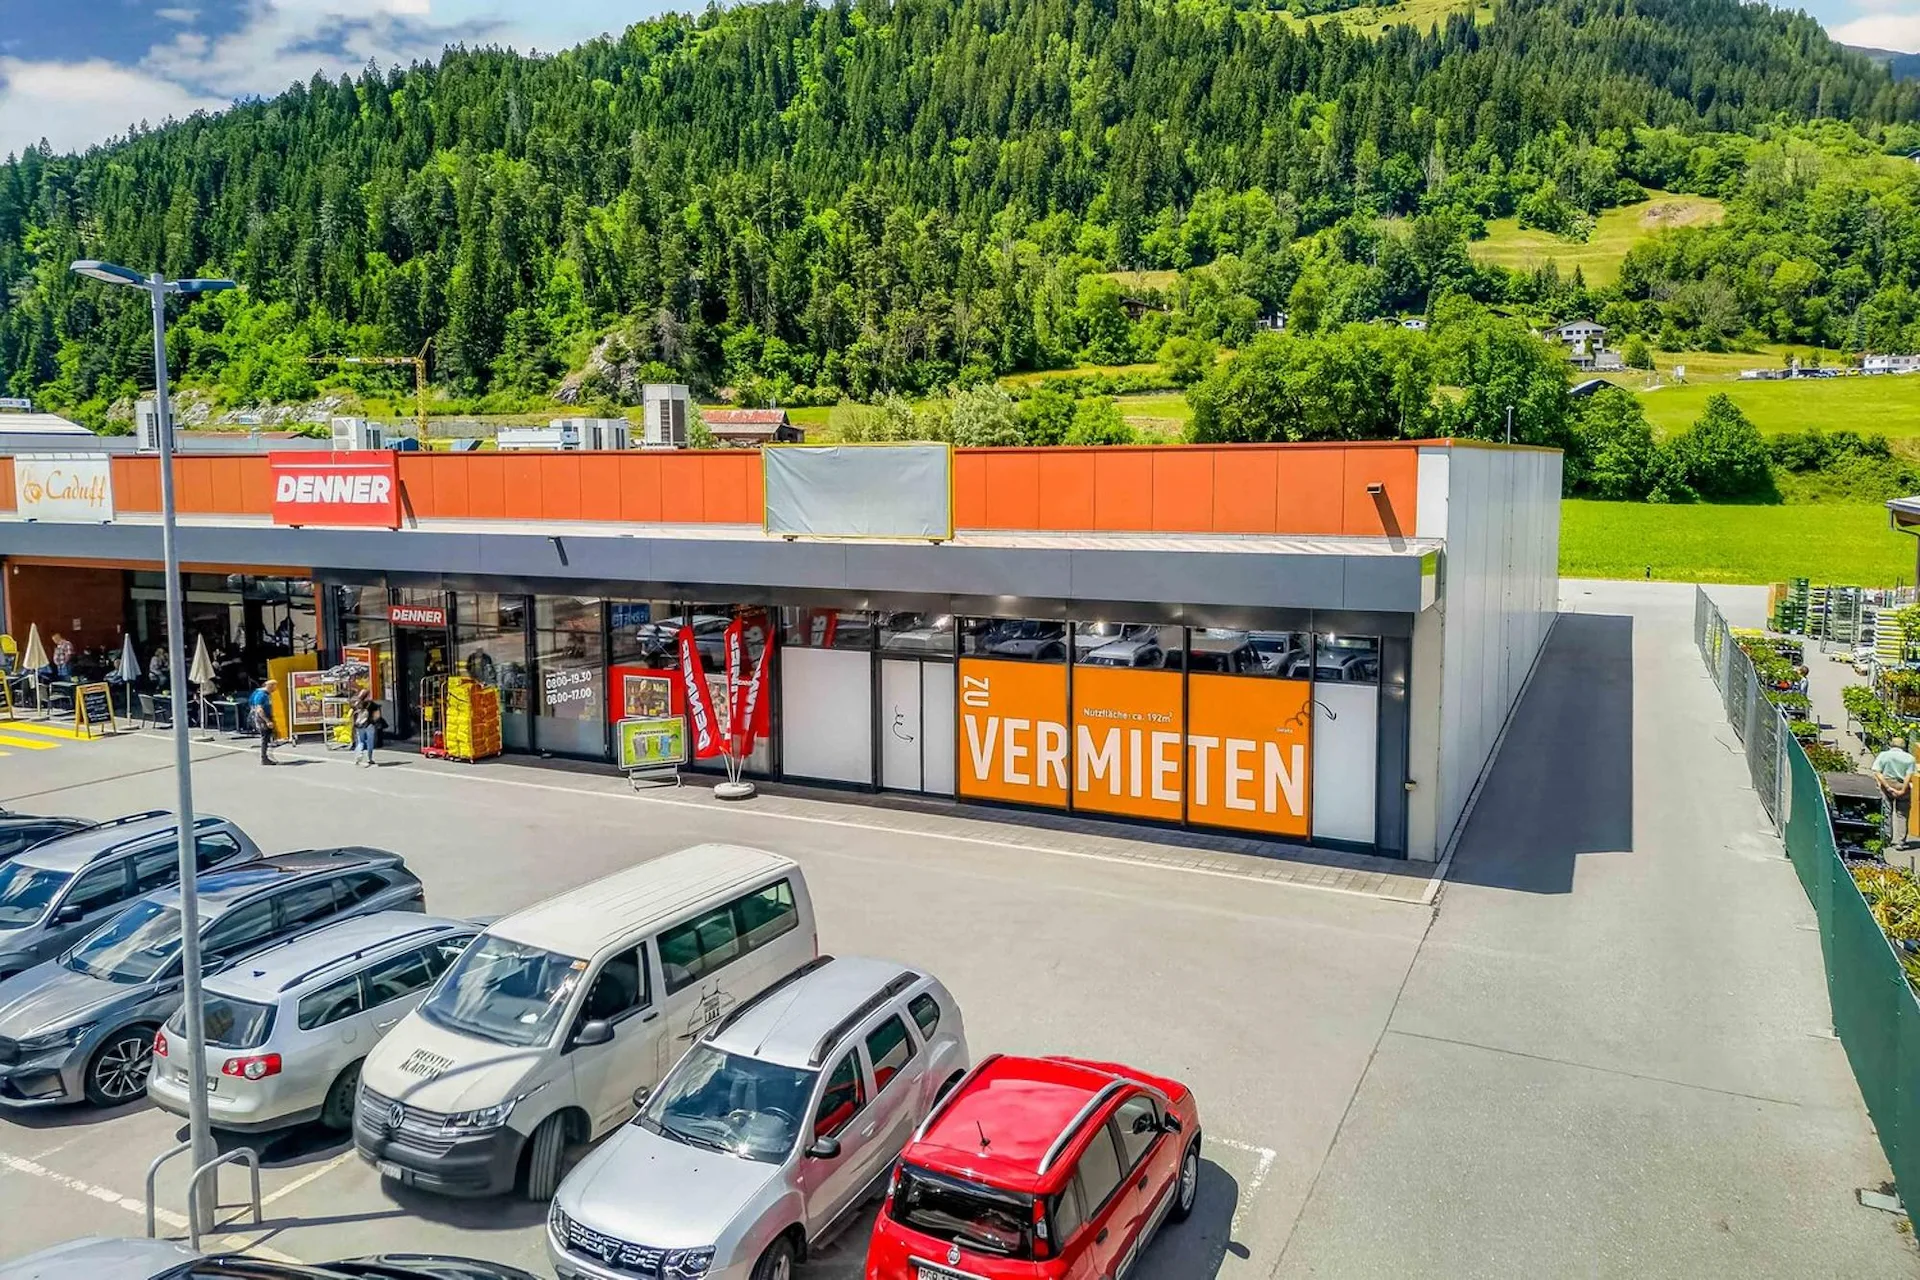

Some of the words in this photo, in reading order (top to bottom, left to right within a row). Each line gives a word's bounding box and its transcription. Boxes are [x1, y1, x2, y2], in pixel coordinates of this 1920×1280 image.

[46, 470, 105, 507] Caduff
[276, 475, 390, 504] DENNER
[392, 609, 442, 623] DENNER
[964, 714, 1304, 816] VERMIETEN
